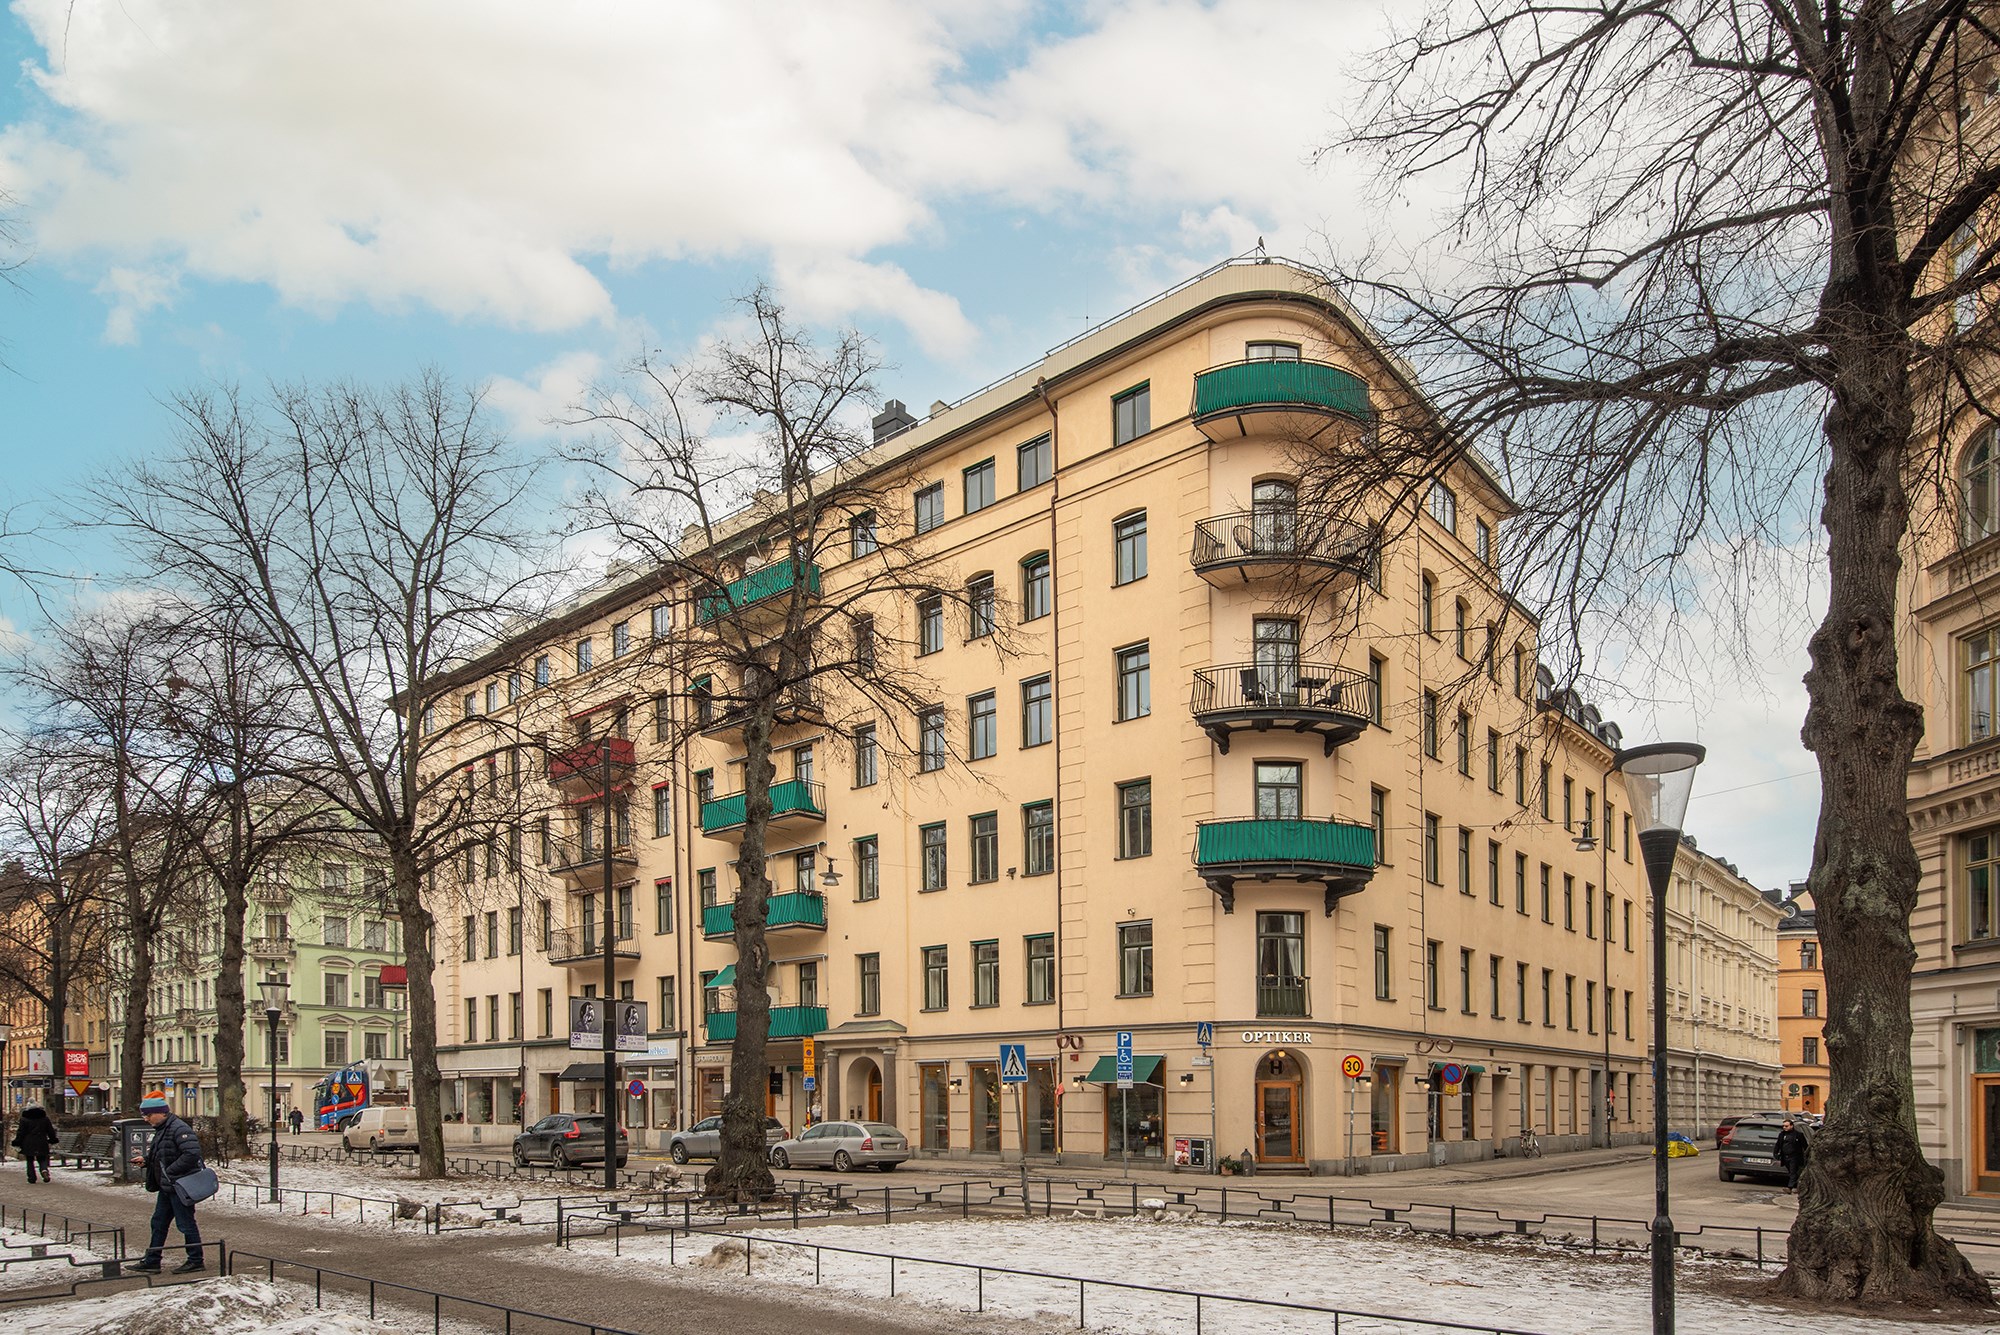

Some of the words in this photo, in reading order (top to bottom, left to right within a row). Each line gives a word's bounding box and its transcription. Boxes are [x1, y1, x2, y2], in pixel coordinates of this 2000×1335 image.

[1120, 1033, 1130, 1046] P
[1242, 1031, 1312, 1043] OPTIKER
[1345, 1060, 1361, 1072] 30
